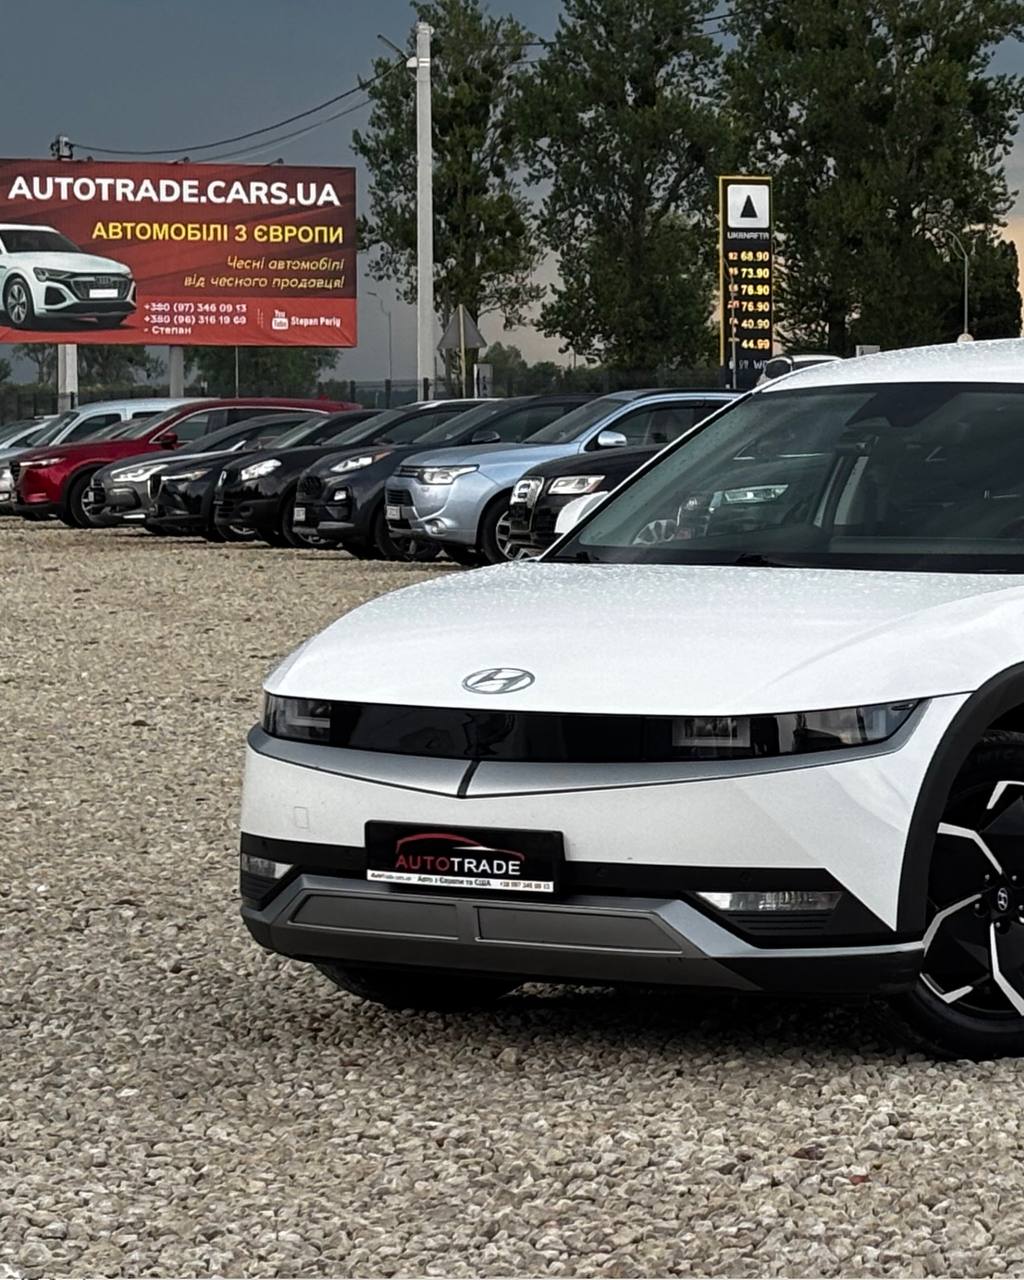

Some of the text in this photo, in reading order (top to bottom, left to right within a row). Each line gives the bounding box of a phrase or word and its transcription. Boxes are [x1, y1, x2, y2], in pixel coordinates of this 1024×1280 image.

[8, 176, 340, 206] AUTOTRADE.CARS.UA
[92, 221, 228, 241] АВТОМОБІЛІ
[254, 224, 344, 243] ЄВРОПИ
[740, 251, 769, 261] 68.90
[227, 255, 344, 271] Чесні автомобілі
[740, 268, 769, 278] 73.90
[184, 273, 345, 290] від чесного продавця!
[740, 284, 769, 294] 76.90
[144, 303, 170, 312] +380
[173, 302, 195, 313] (97)
[197, 304, 216, 312] 346
[219, 304, 233, 312] 09
[741, 301, 769, 311] 76.90
[144, 315, 170, 324] +380
[173, 315, 195, 325] (96)
[198, 316, 216, 324] 316
[219, 316, 230, 324] 19
[291, 316, 319, 326] Stepan
[741, 319, 769, 329] 40.90
[152, 326, 192, 335] Степан
[395, 854, 521, 875] AUTOTRADE
